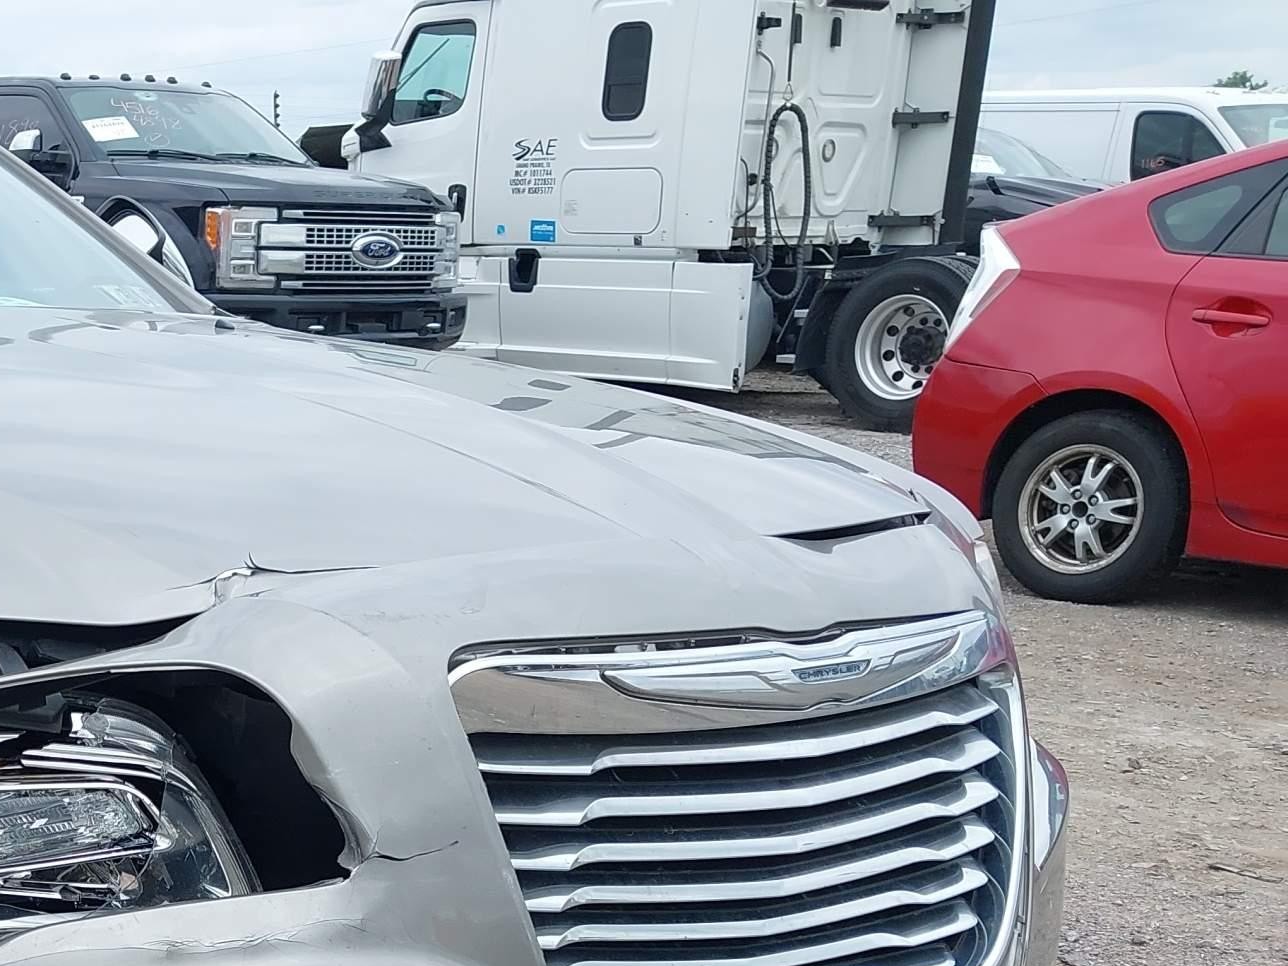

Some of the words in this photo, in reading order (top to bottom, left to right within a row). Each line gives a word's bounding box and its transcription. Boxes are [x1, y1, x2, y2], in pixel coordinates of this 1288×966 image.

[512, 138, 558, 161] SAE
[367, 242, 391, 257] Ford
[799, 663, 861, 679] CHRYSLER
